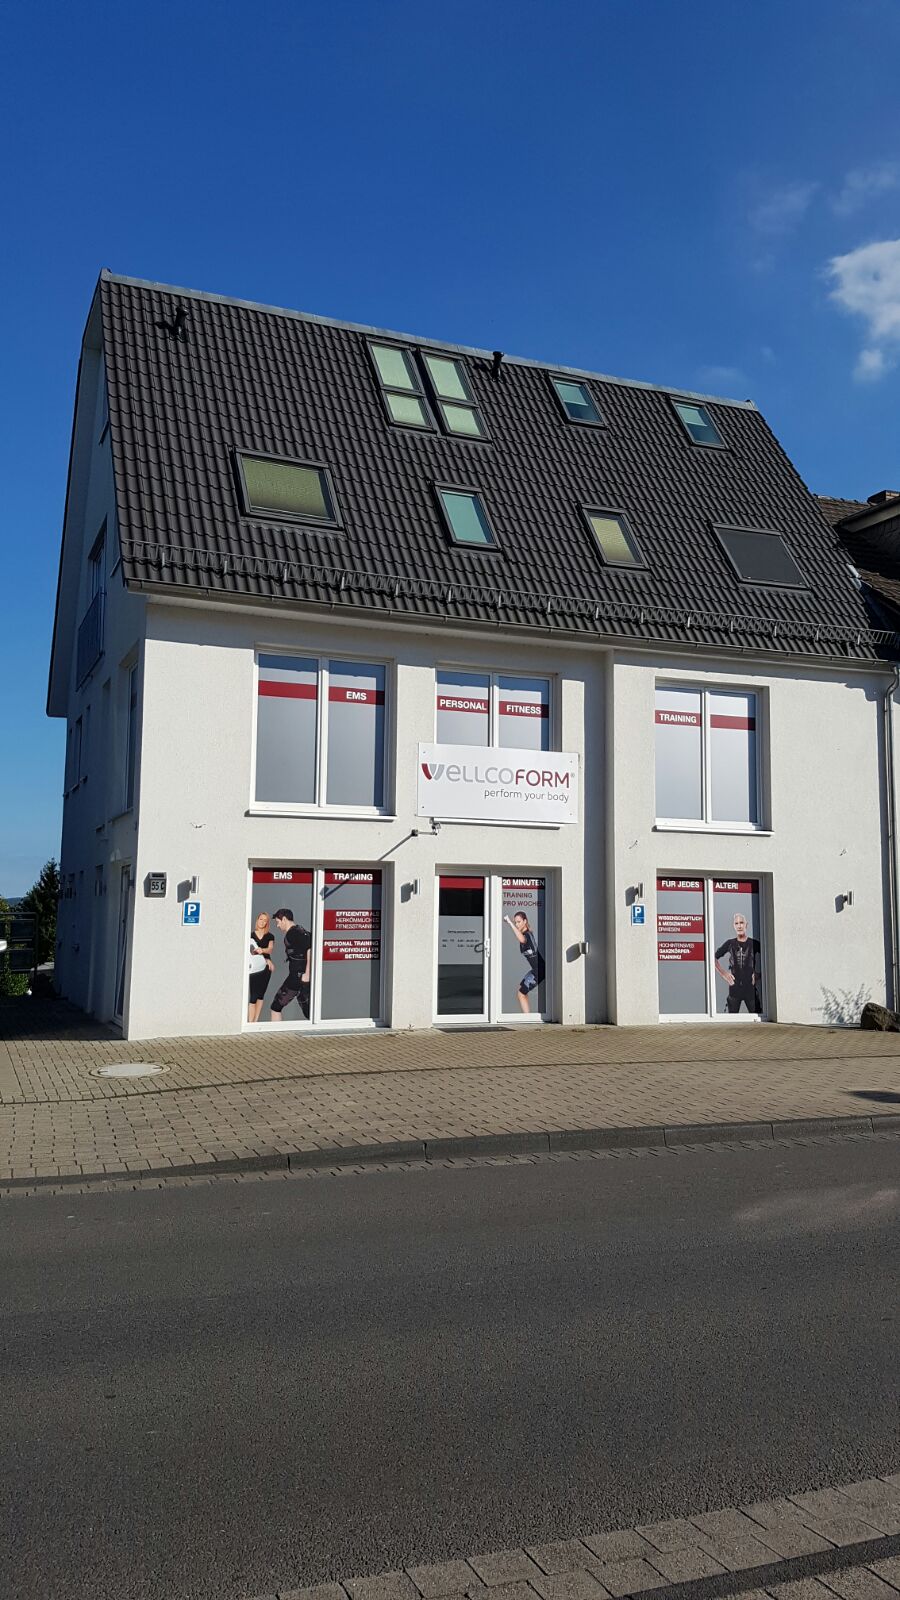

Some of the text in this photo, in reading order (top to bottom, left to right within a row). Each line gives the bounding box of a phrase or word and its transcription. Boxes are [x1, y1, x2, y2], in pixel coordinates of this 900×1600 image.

[346, 691, 367, 701] EMS
[440, 699, 542, 715] PERSONAL FITNESS
[659, 713, 697, 724] TRAINING
[484, 789, 570, 804] perform your body
[273, 871, 373, 881] EMS TRAINING
[151, 881, 160, 891] 55
[512, 879, 545, 887] MINUTEN
[661, 879, 739, 890] FÜR JEDES ALTER!
[187, 903, 197, 916] P
[634, 906, 642, 917] P
